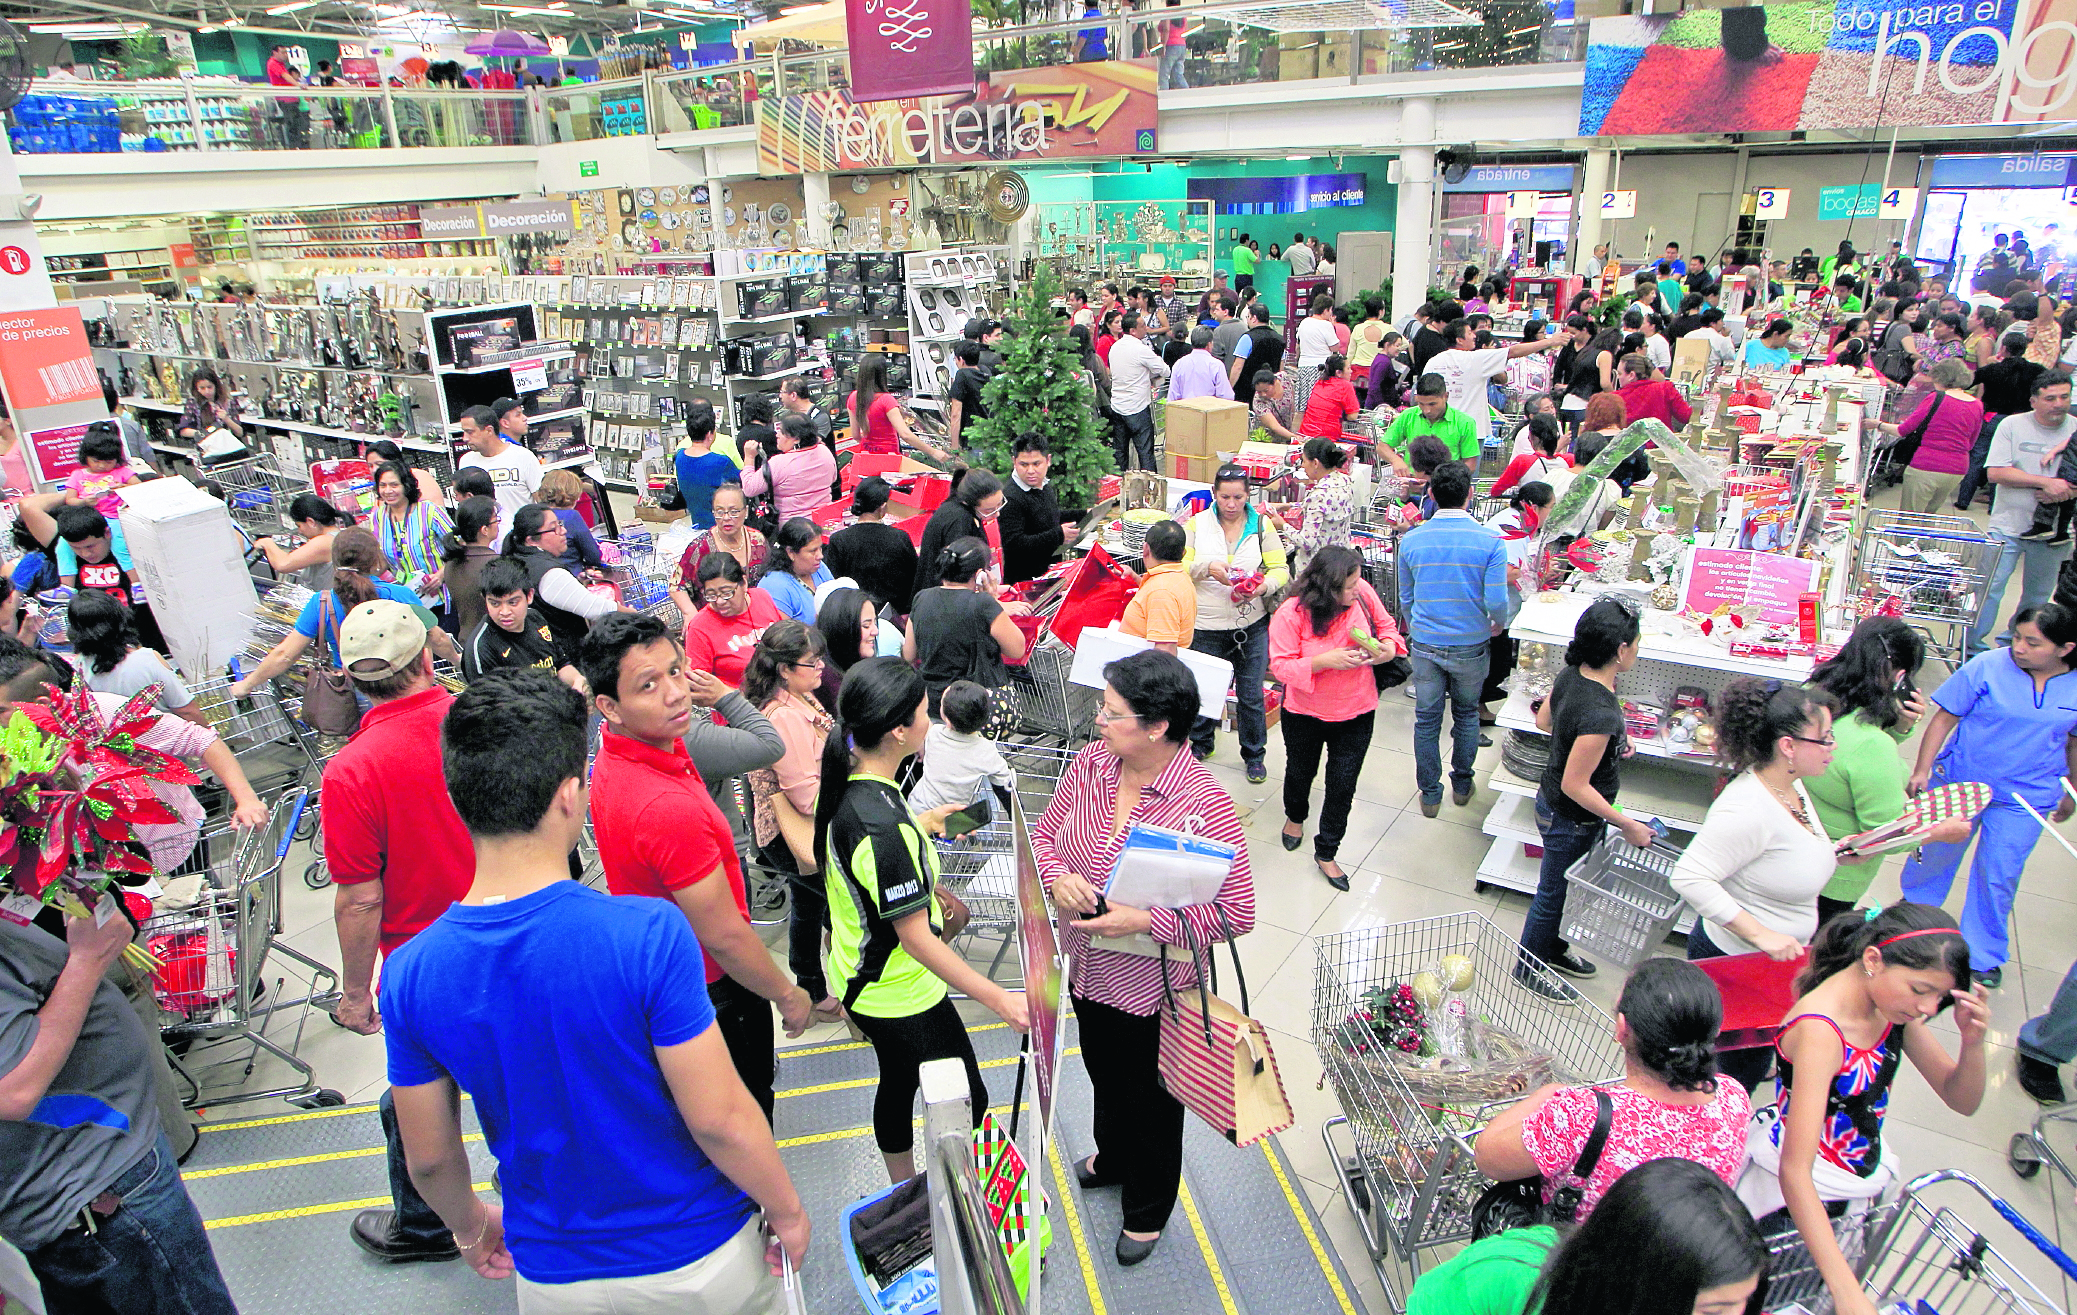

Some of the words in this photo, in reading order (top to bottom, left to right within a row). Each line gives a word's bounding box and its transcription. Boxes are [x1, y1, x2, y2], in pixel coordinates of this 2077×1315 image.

[1804, 8, 1876, 34] Todo
[1893, 5, 1964, 33] para
[1974, 0, 2000, 21] el
[1310, 190, 1331, 203] servicio
[1332, 190, 1340, 201] al
[1341, 188, 1364, 201] cliente
[1602, 193, 1616, 208] 2
[1758, 191, 1775, 208] 3
[1823, 194, 1877, 211] bodas
[1883, 189, 1900, 208] 4
[424, 215, 475, 232] Decoración
[488, 210, 567, 229] Decoración
[2, 330, 19, 342] de
[23, 325, 70, 342] precios
[1698, 561, 1733, 569] estimado
[1748, 588, 1777, 598] cambio,
[1758, 581, 1775, 590] final
[1753, 598, 1788, 607] empaque
[884, 883, 906, 903] MARZO
[904, 878, 919, 897] 2013
